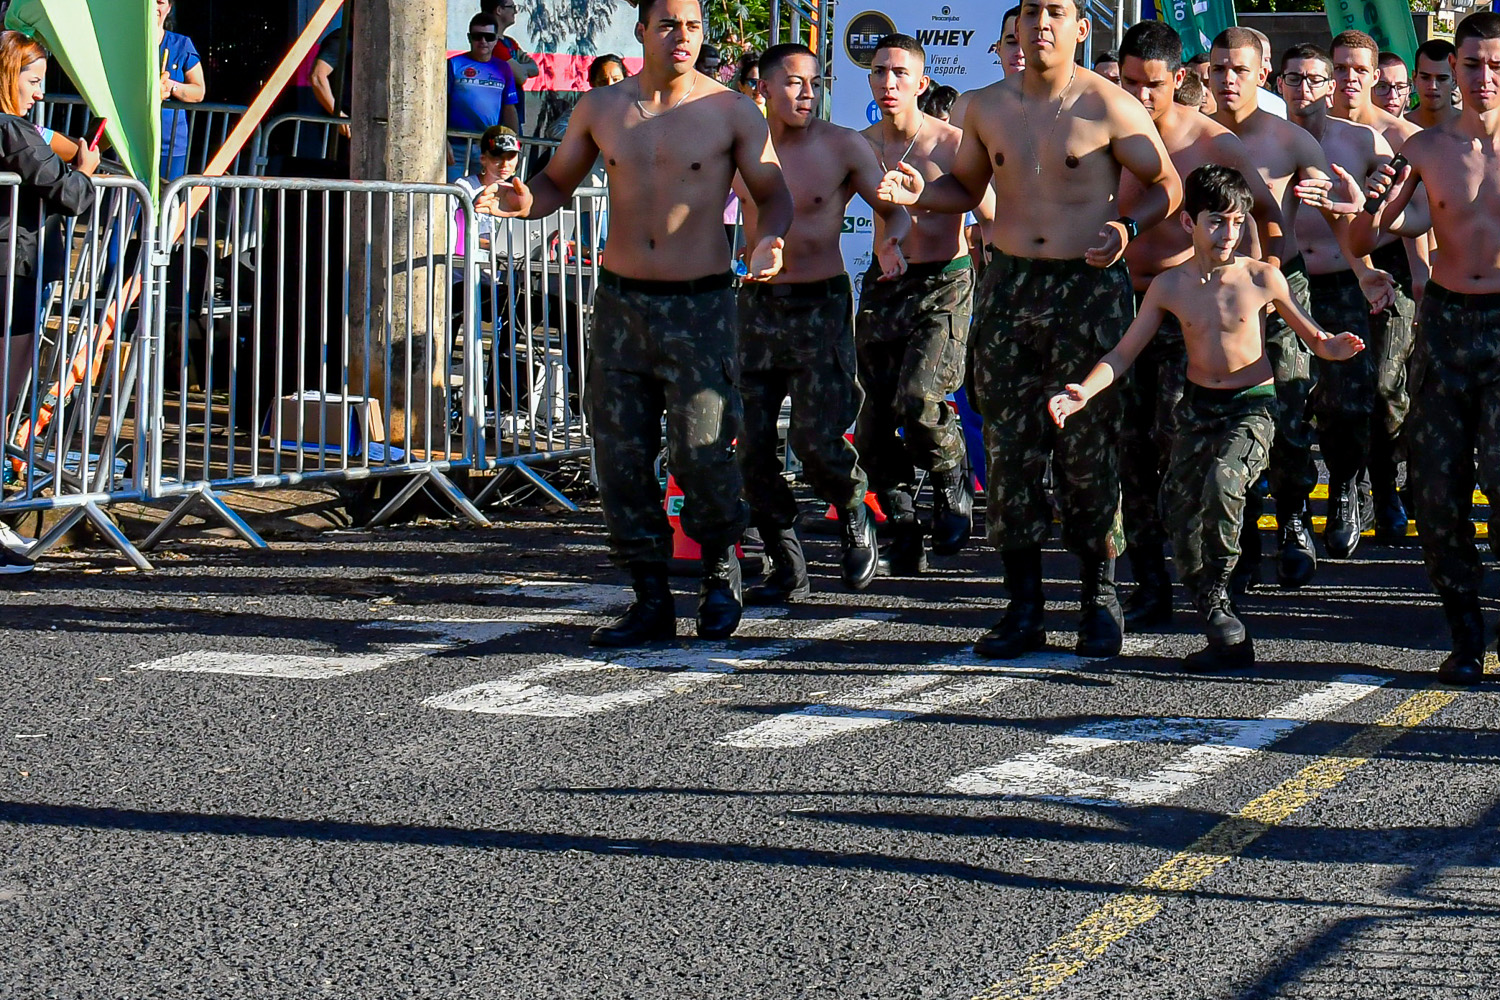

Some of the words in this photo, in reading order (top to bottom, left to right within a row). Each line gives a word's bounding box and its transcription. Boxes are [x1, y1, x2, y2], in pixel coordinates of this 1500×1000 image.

[915, 29, 975, 47] WHEY
[930, 54, 951, 64] Viver
[953, 55, 959, 64] é
[933, 66, 967, 77] esporte.
